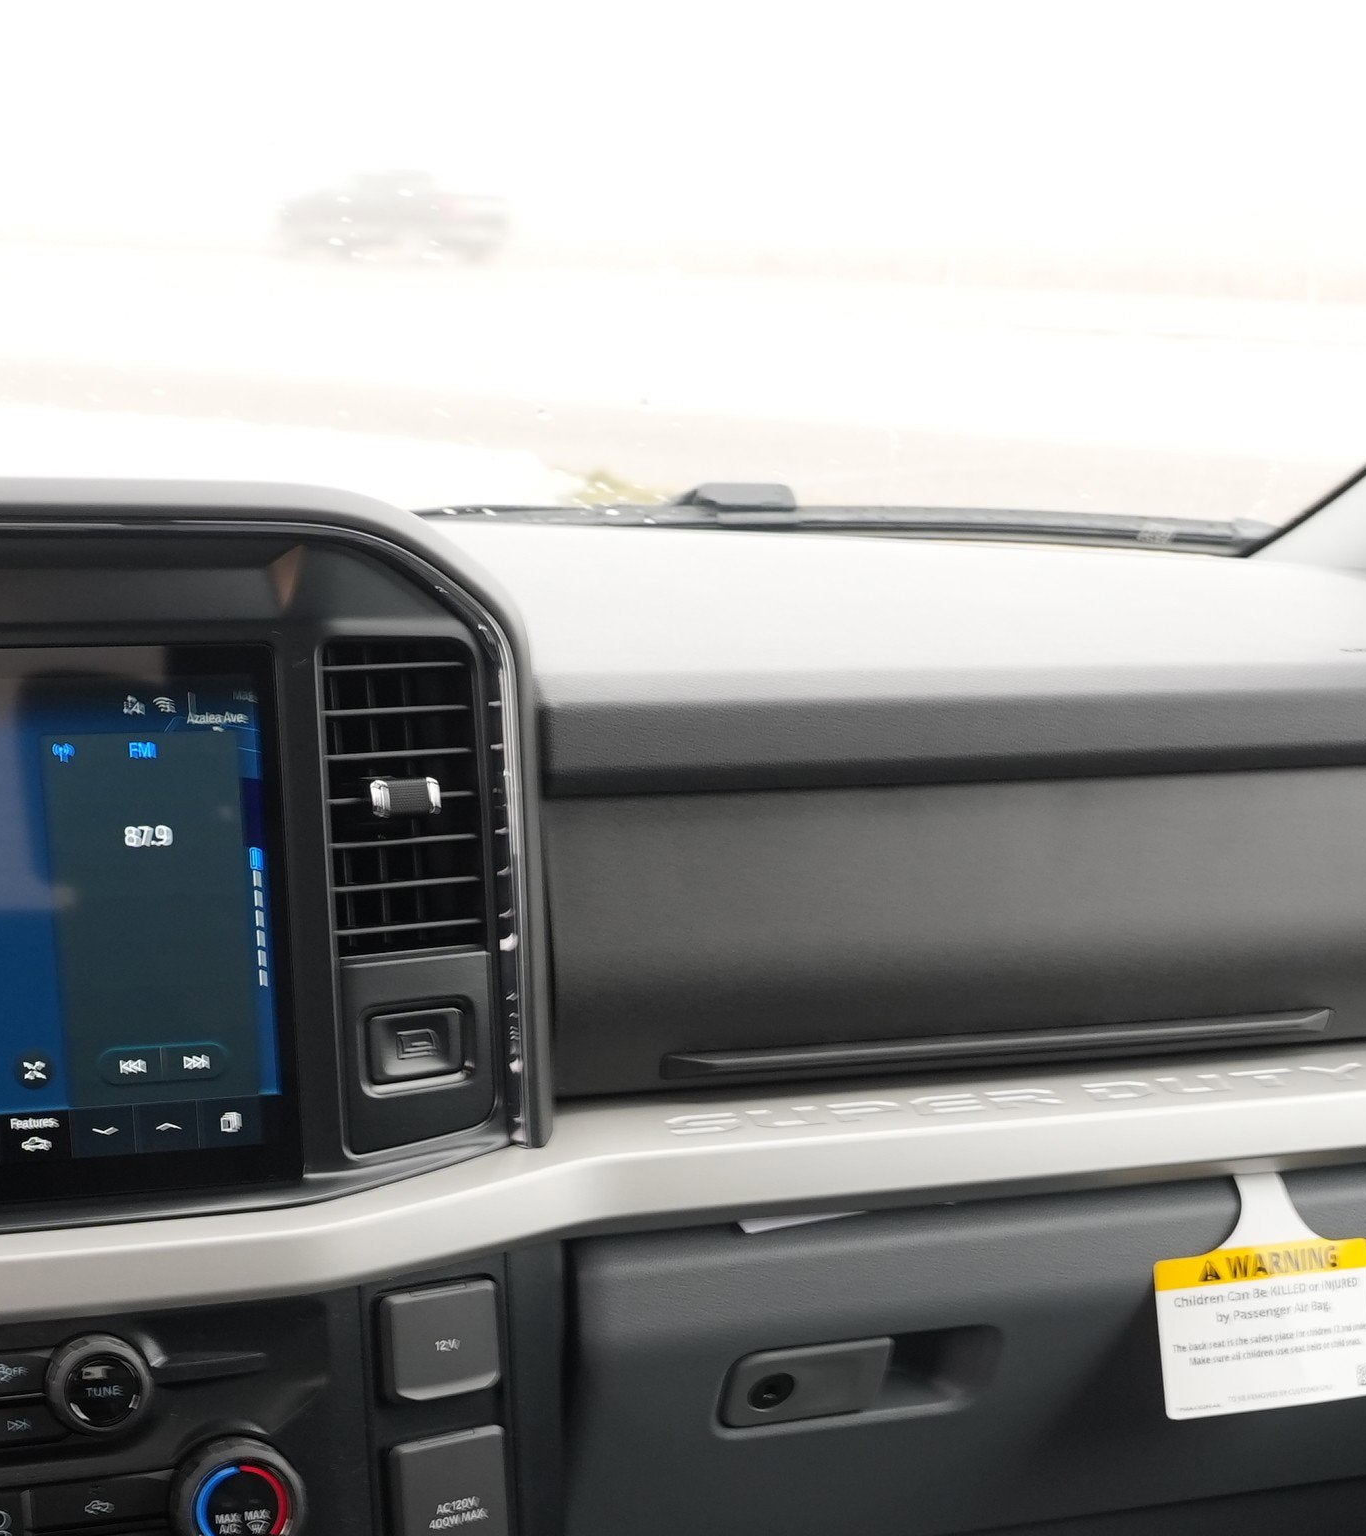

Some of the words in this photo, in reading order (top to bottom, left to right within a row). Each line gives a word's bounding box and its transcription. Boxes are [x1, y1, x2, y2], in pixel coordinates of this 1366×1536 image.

[187, 712, 223, 725] Azalea
[224, 711, 249, 724] Ave
[124, 825, 173, 847] 87.9
[664, 1088, 1064, 1135] SUPER
[1082, 1061, 1363, 1100] DUTY
[10, 1118, 60, 1130] Features
[1225, 1245, 1339, 1279] WARNING
[1174, 1294, 1224, 1308] Children
[1228, 1290, 1249, 1301] Can
[1253, 1288, 1267, 1298] Be
[1270, 1283, 1306, 1296] KILLED
[1309, 1283, 1318, 1292] or
[1321, 1277, 1358, 1292] INJURED
[1216, 1312, 1229, 1324] by
[1233, 1305, 1291, 1320] Passenger
[1295, 1302, 1308, 1312] Air
[1173, 1344, 1187, 1353] The
[1210, 1340, 1225, 1349] seat
[1235, 1336, 1248, 1346] the
[1275, 1331, 1294, 1342] place
[1189, 1356, 1211, 1366] Make
[1243, 1349, 1274, 1360] children
[1275, 1347, 1289, 1356] use
[1291, 1345, 1306, 1354] seat
[6, 1366, 28, 1376] OFF
[85, 1385, 123, 1397] TUNE
[436, 1502, 454, 1514] AC
[452, 1496, 480, 1510] 120V
[215, 1512, 242, 1524] MAX
[244, 1509, 271, 1521] MAX
[429, 1514, 462, 1529] 400W
[462, 1508, 489, 1522] MAX
[219, 1523, 241, 1535] A/C
